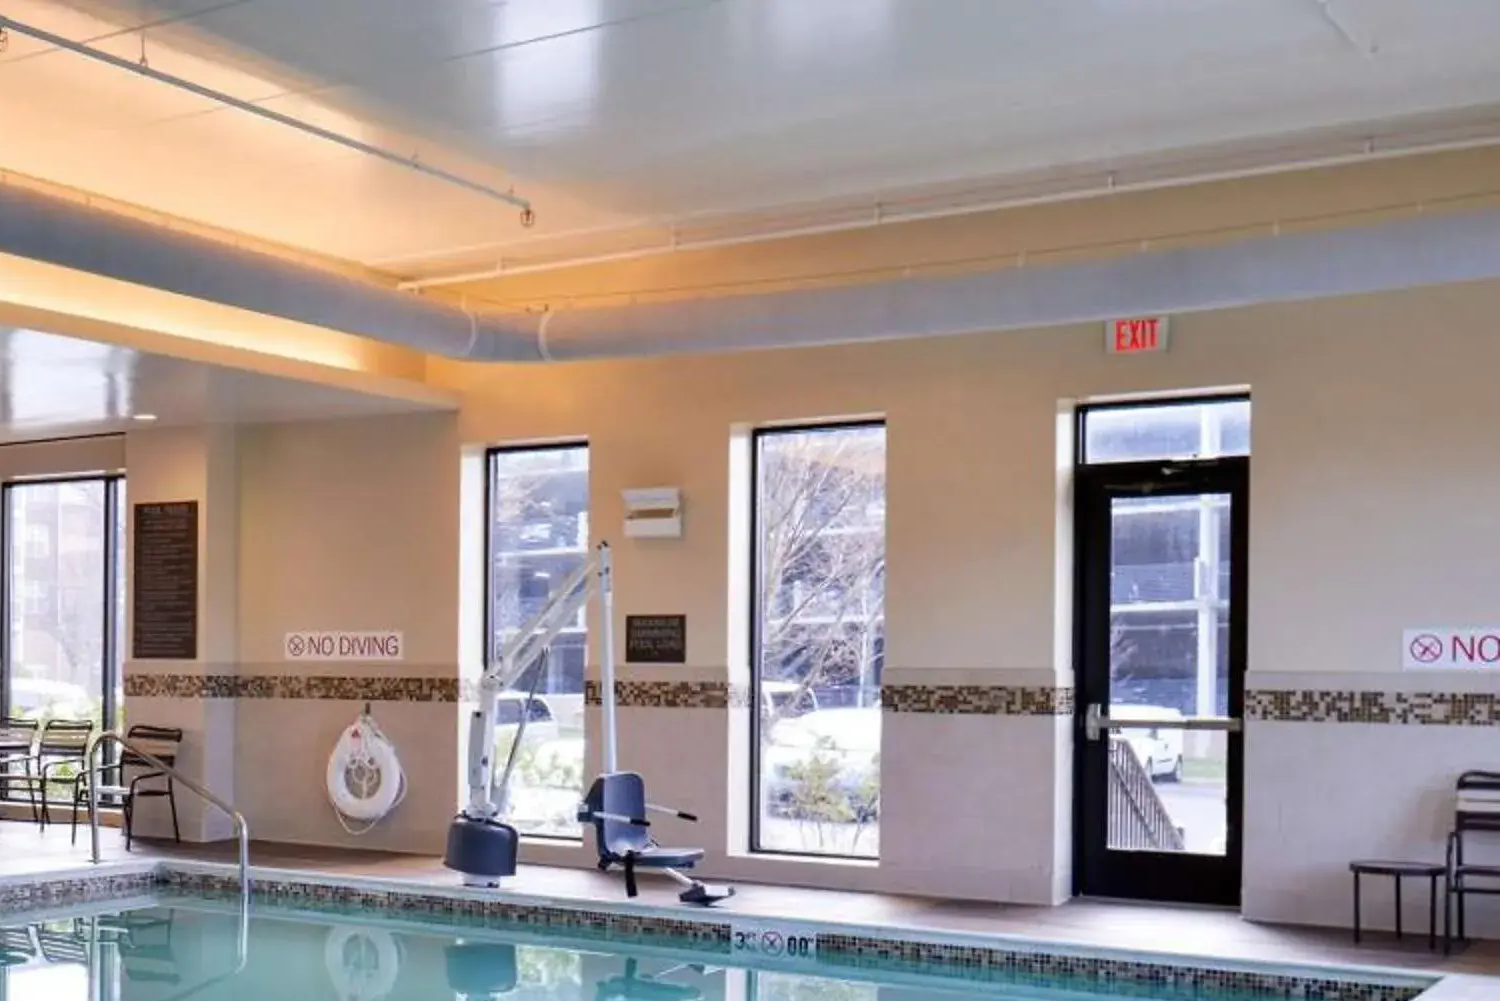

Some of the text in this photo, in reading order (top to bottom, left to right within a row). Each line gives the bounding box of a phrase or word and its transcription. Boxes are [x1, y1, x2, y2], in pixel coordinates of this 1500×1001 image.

[1115, 319, 1157, 351] EXIT
[308, 635, 399, 656] NO DIVING
[1451, 635, 1500, 663] NO
